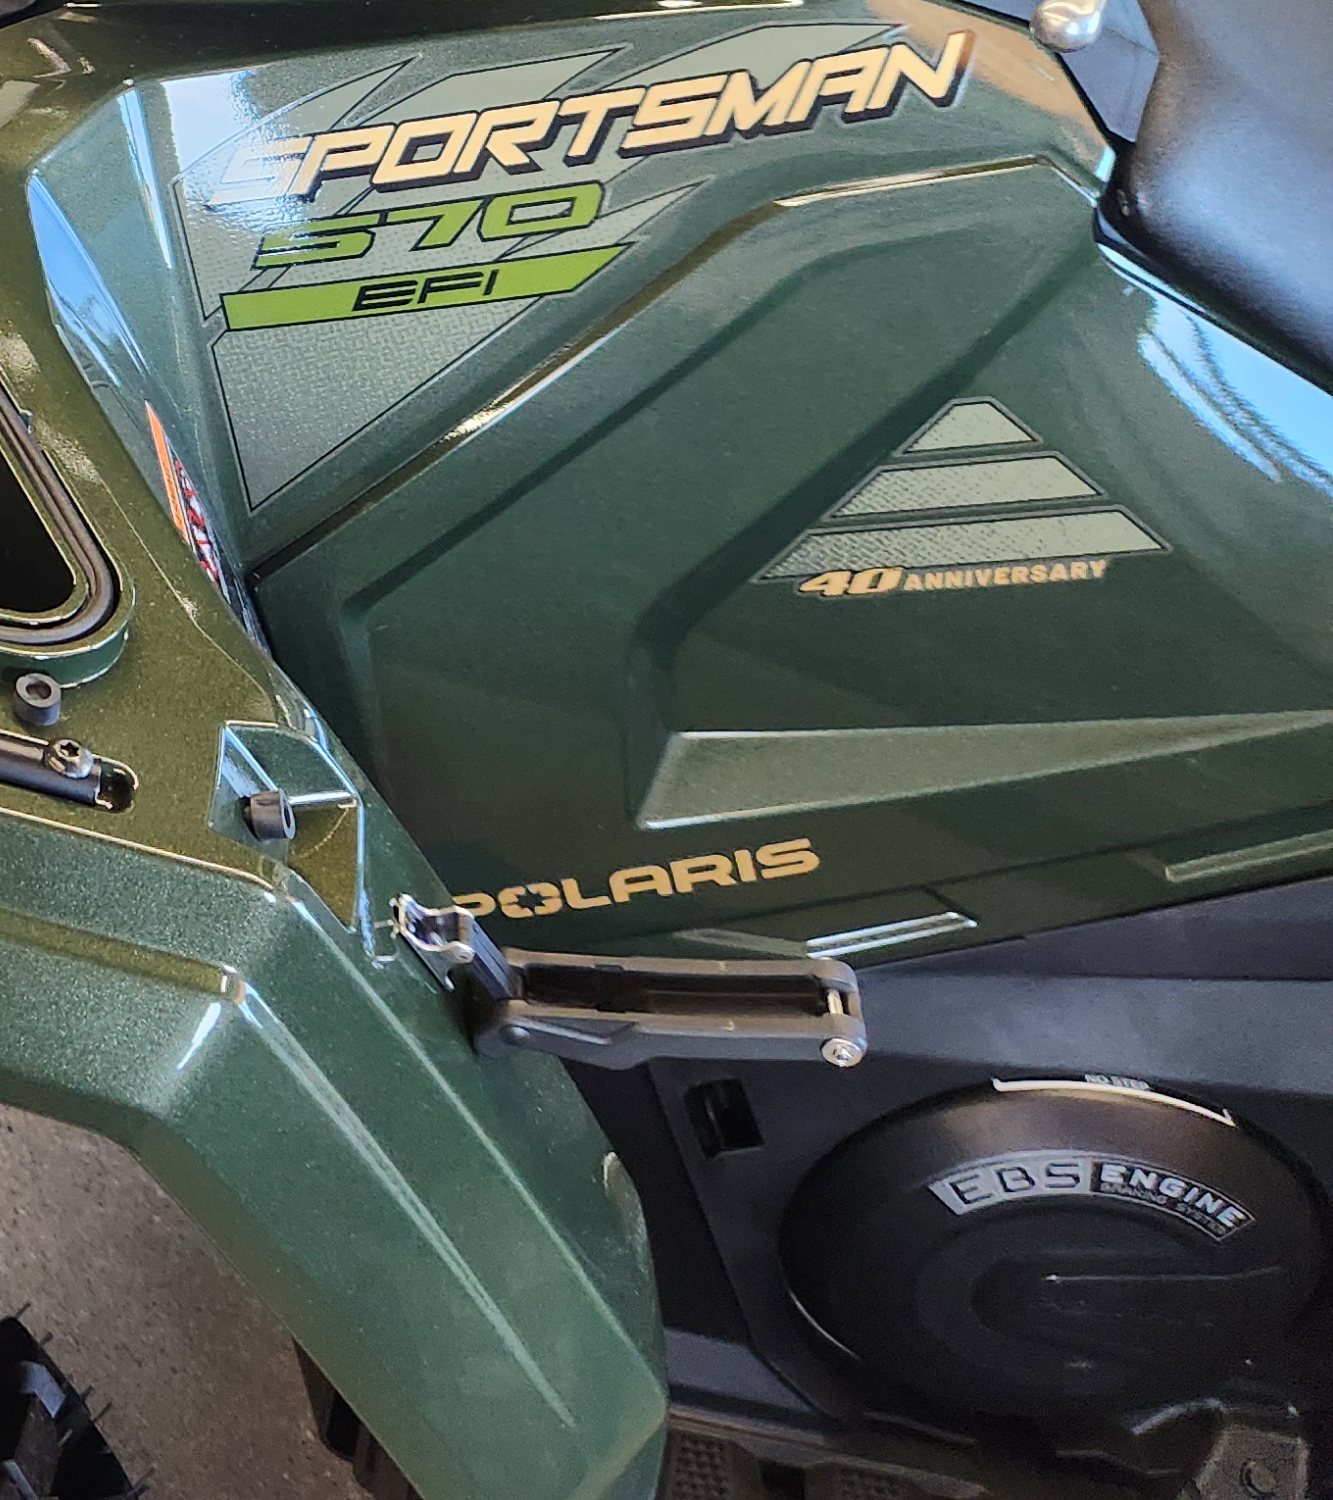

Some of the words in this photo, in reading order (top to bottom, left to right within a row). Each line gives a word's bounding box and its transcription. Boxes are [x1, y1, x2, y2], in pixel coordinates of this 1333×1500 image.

[205, 28, 974, 206] SPORTSMAN
[251, 181, 605, 269] 570
[351, 269, 498, 313] EFI
[798, 566, 904, 596] 40
[902, 559, 1108, 592] ANNIVERSARY
[453, 838, 820, 919] POLARIS
[947, 1161, 1082, 1207] EBS
[1099, 1162, 1247, 1229] ENGINE
